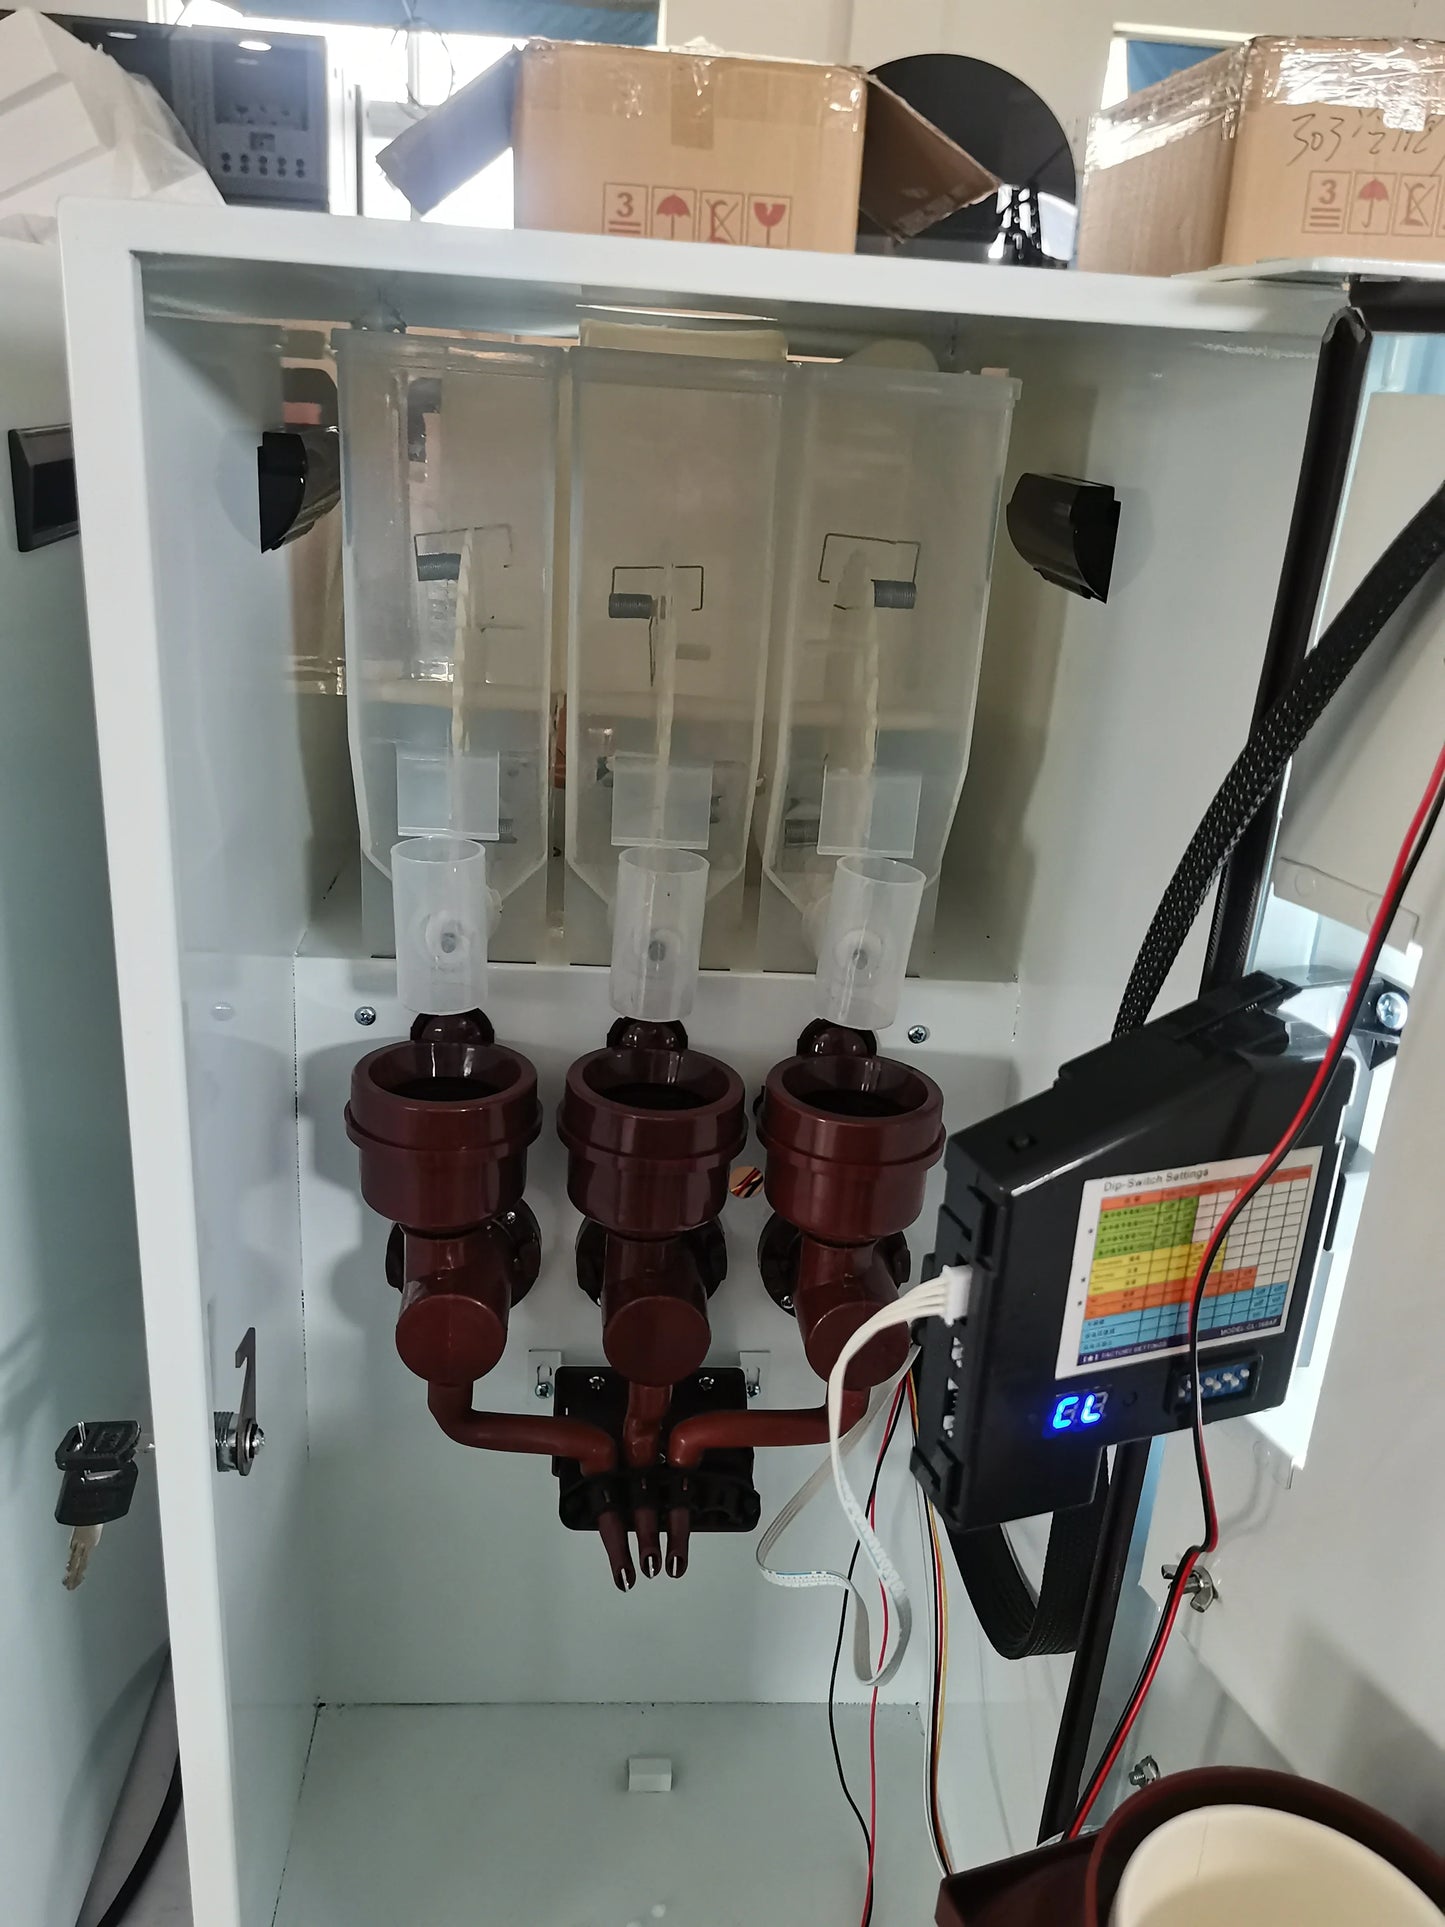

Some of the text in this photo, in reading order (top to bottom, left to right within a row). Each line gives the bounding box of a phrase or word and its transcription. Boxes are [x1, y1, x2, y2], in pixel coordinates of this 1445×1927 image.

[1286, 113, 1344, 166] 303
[616, 192, 635, 218] 3
[1318, 179, 1336, 205] 3
[1166, 1168, 1209, 1183] Settings
